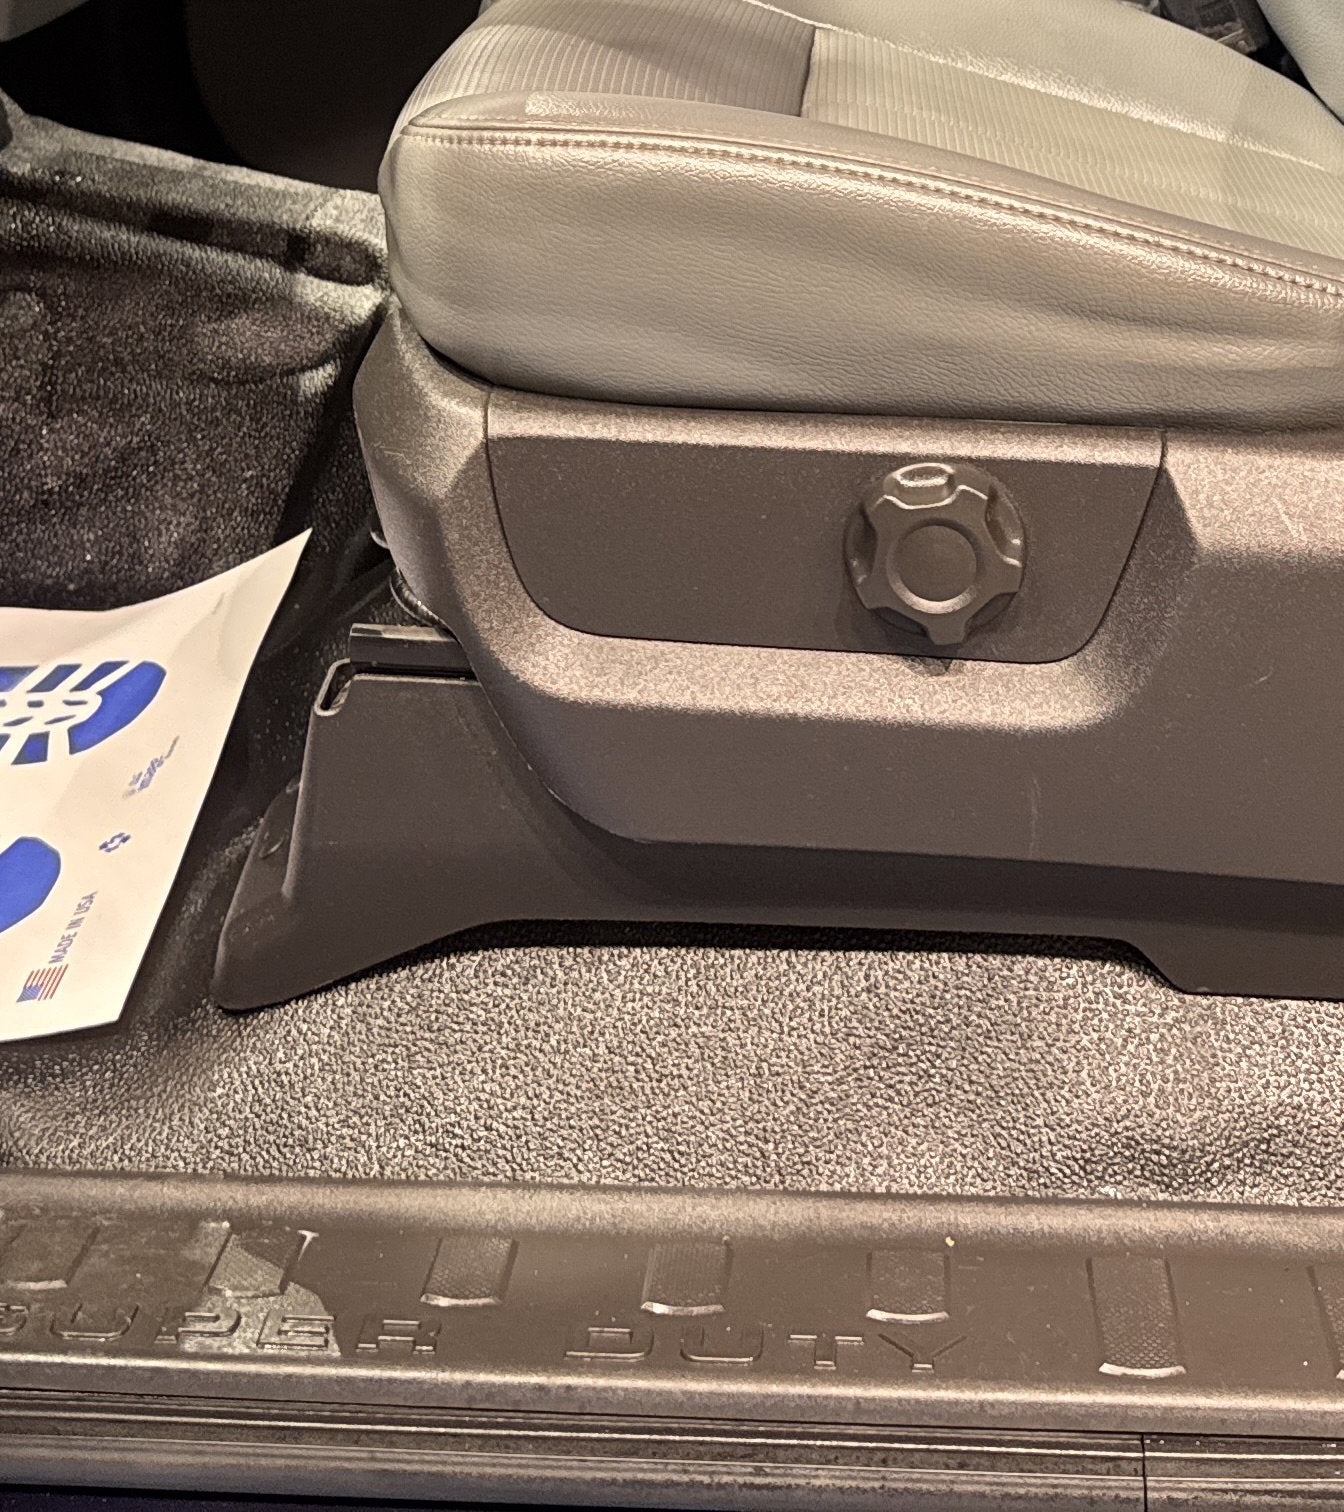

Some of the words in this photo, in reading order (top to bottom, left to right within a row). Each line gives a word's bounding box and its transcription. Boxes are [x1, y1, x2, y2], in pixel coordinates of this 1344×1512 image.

[73, 891, 98, 916] USA
[66, 916, 85, 930] IN
[48, 931, 77, 964] MADE
[563, 1321, 968, 1373] DUTY
